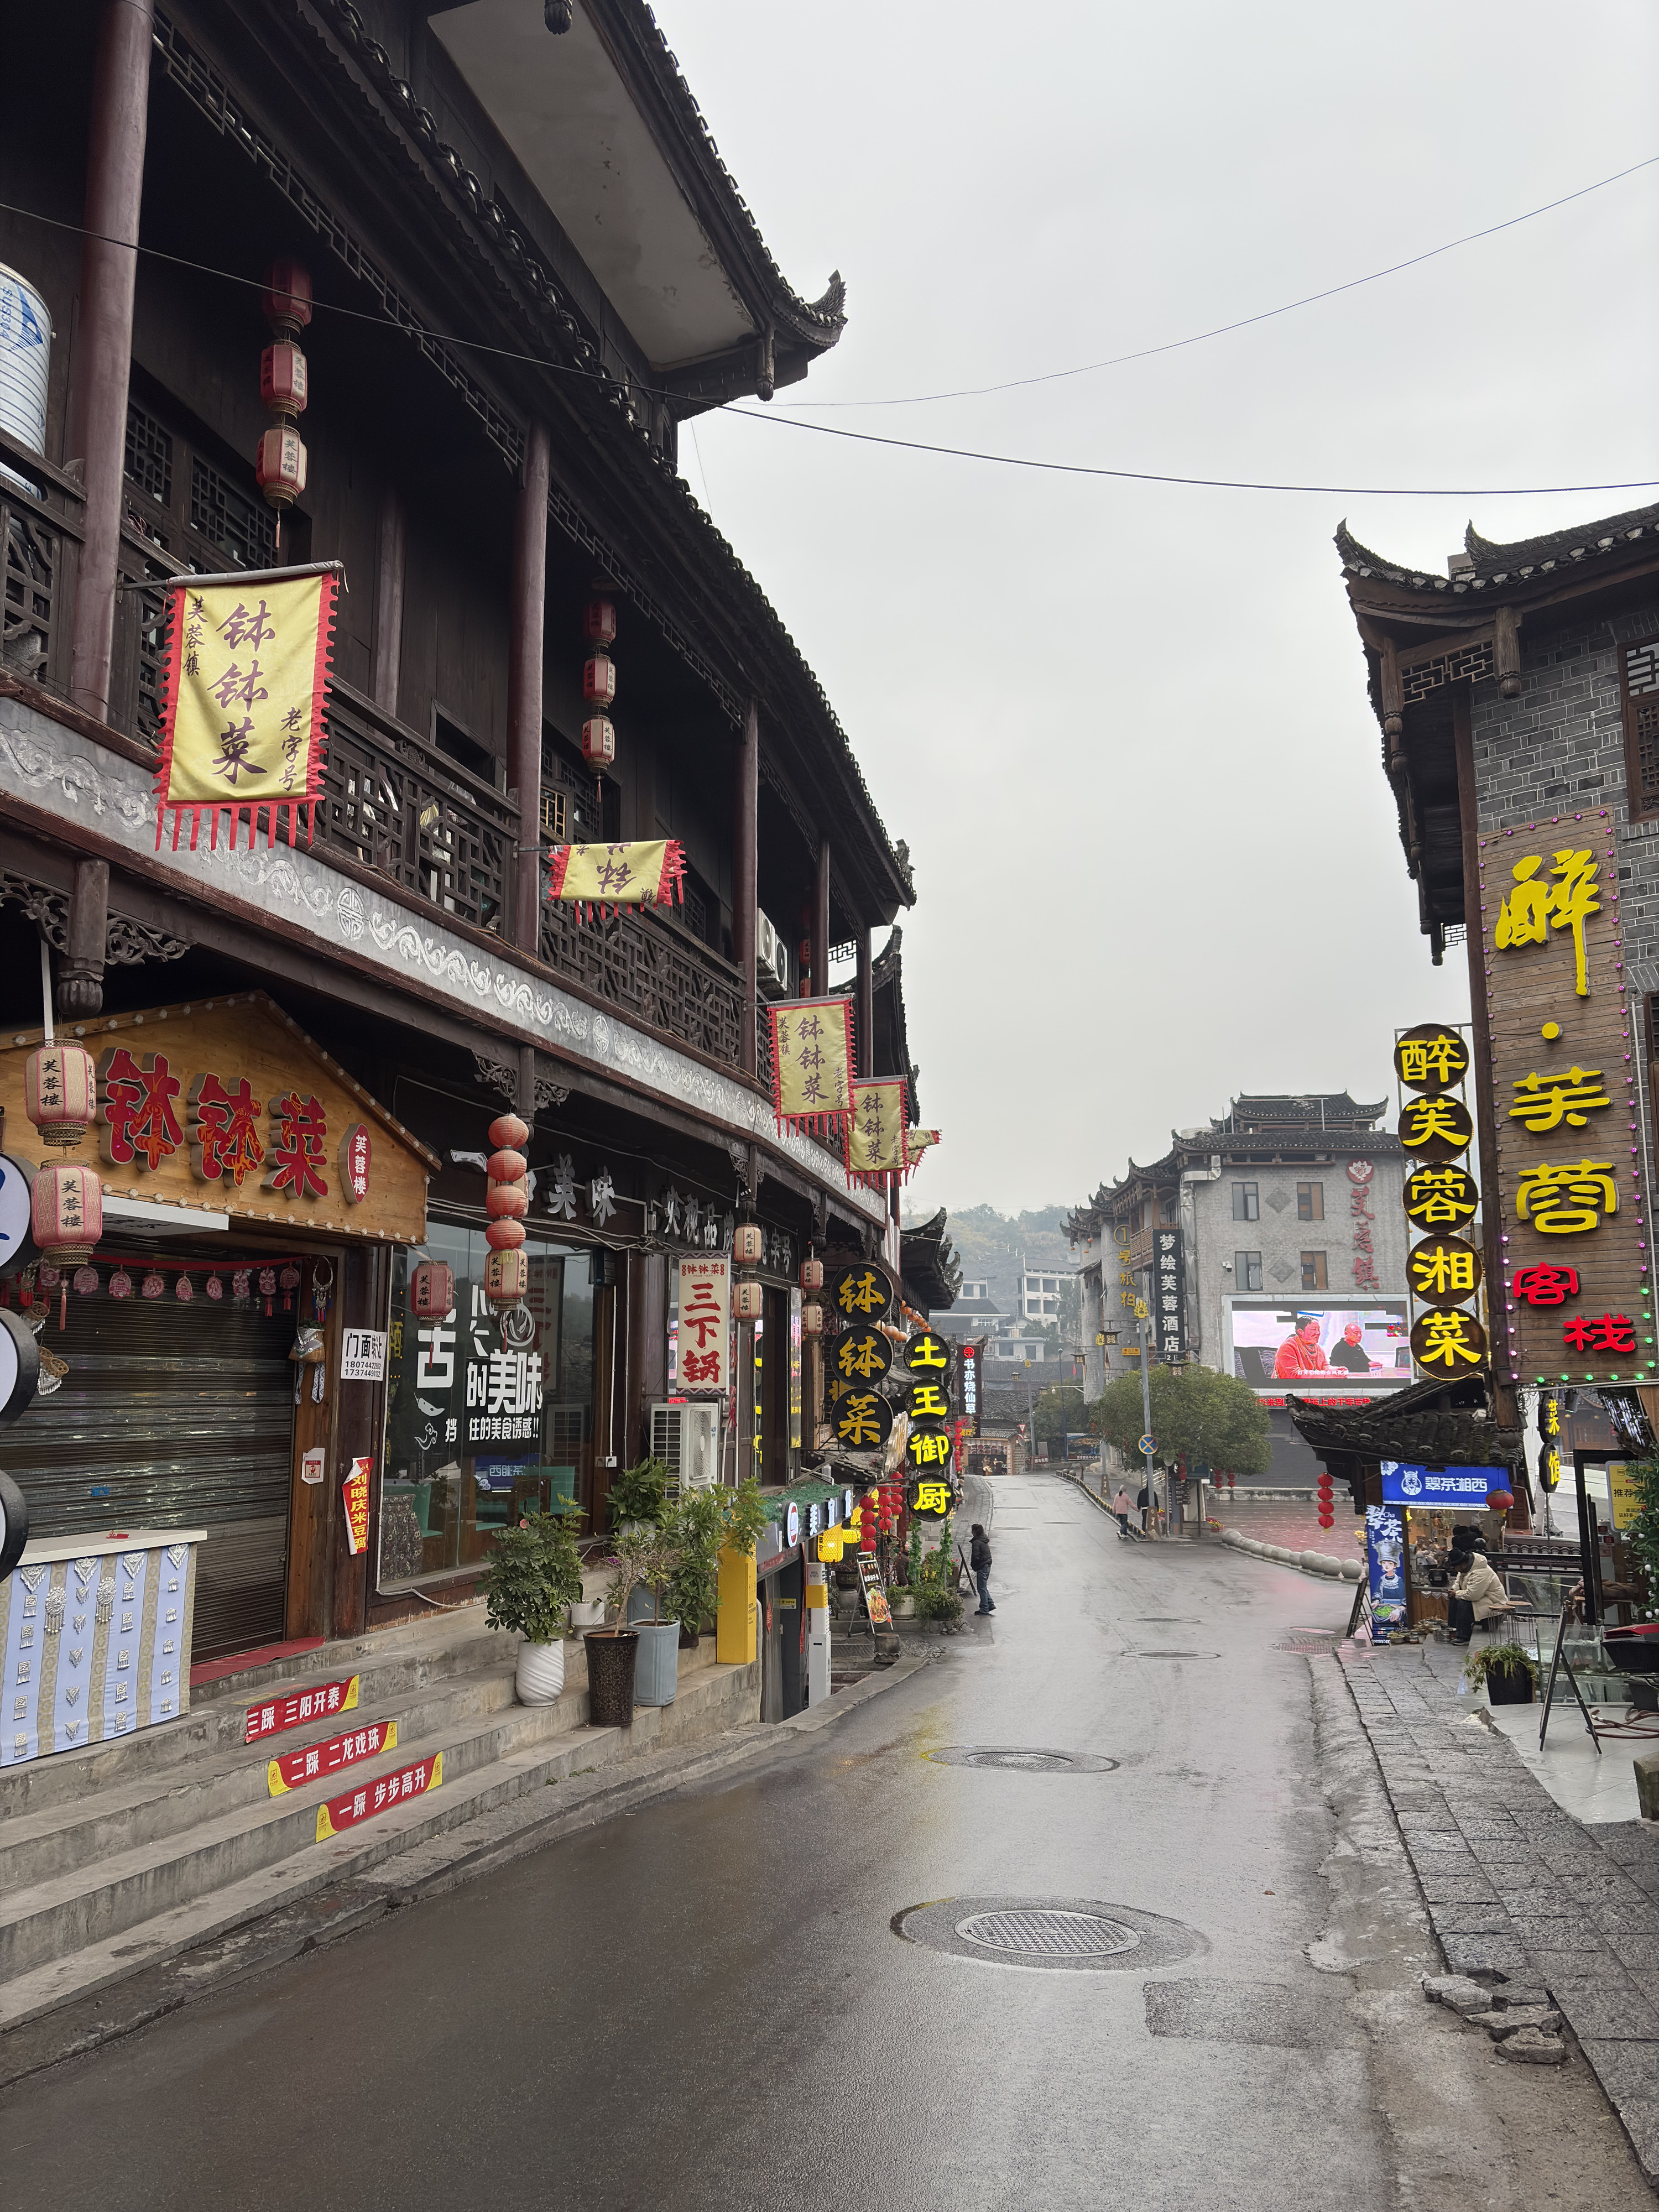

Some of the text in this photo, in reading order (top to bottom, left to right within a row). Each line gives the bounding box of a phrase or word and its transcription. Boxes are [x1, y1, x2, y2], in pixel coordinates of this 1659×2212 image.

[282, 439, 297, 474] 芙蓉楼
[185, 596, 207, 677] 芙蓉镇
[207, 599, 275, 785] 钵钵菜
[278, 706, 302, 791] 老字号
[603, 726, 612, 752] 芙蓉楼
[779, 1015, 791, 1056] 芙蓉镇
[794, 1014, 830, 1105] 钵钵菜
[40, 1059, 64, 1107] 芙蓉楼
[833, 1067, 844, 1107] 老字号
[106, 1047, 328, 1198] 钵钵菜
[860, 1092, 888, 1165] 钵钵菜
[353, 1134, 367, 1196] 芙蓉楼
[890, 1134, 899, 1166] 老字号
[60, 1179, 84, 1228] 芙蓉楼
[1399, 1033, 1483, 1367] 醉芙蓉湘菜
[687, 1263, 719, 1274] 钵钵菜
[745, 1233, 754, 1254] 芙蓉楼
[418, 1275, 430, 1306] 芙蓉楼
[489, 1258, 502, 1288] 芙蓉楼
[518, 1258, 526, 1288] 芙蓉楼
[1160, 1234, 1179, 1352] 梦绘芙蓉酒店
[740, 1289, 749, 1311] 芙蓉楼
[346, 1333, 382, 1359] 门面转让
[682, 1282, 721, 1384] 三下锅
[838, 1272, 885, 1444] 钵钵菜
[963, 1358, 976, 1414] 书亦烧仙草
[910, 1337, 951, 1514] 土王御厨
[1425, 1477, 1488, 1492] 翠茶湘西
[350, 1474, 367, 1550] 刘晓庆米豆腐
[248, 1687, 340, 1734] 三踩 三阳开泰
[291, 1727, 379, 1781] 二踩 二龙戏珠
[340, 1765, 426, 1818] 一踩 步步高升
